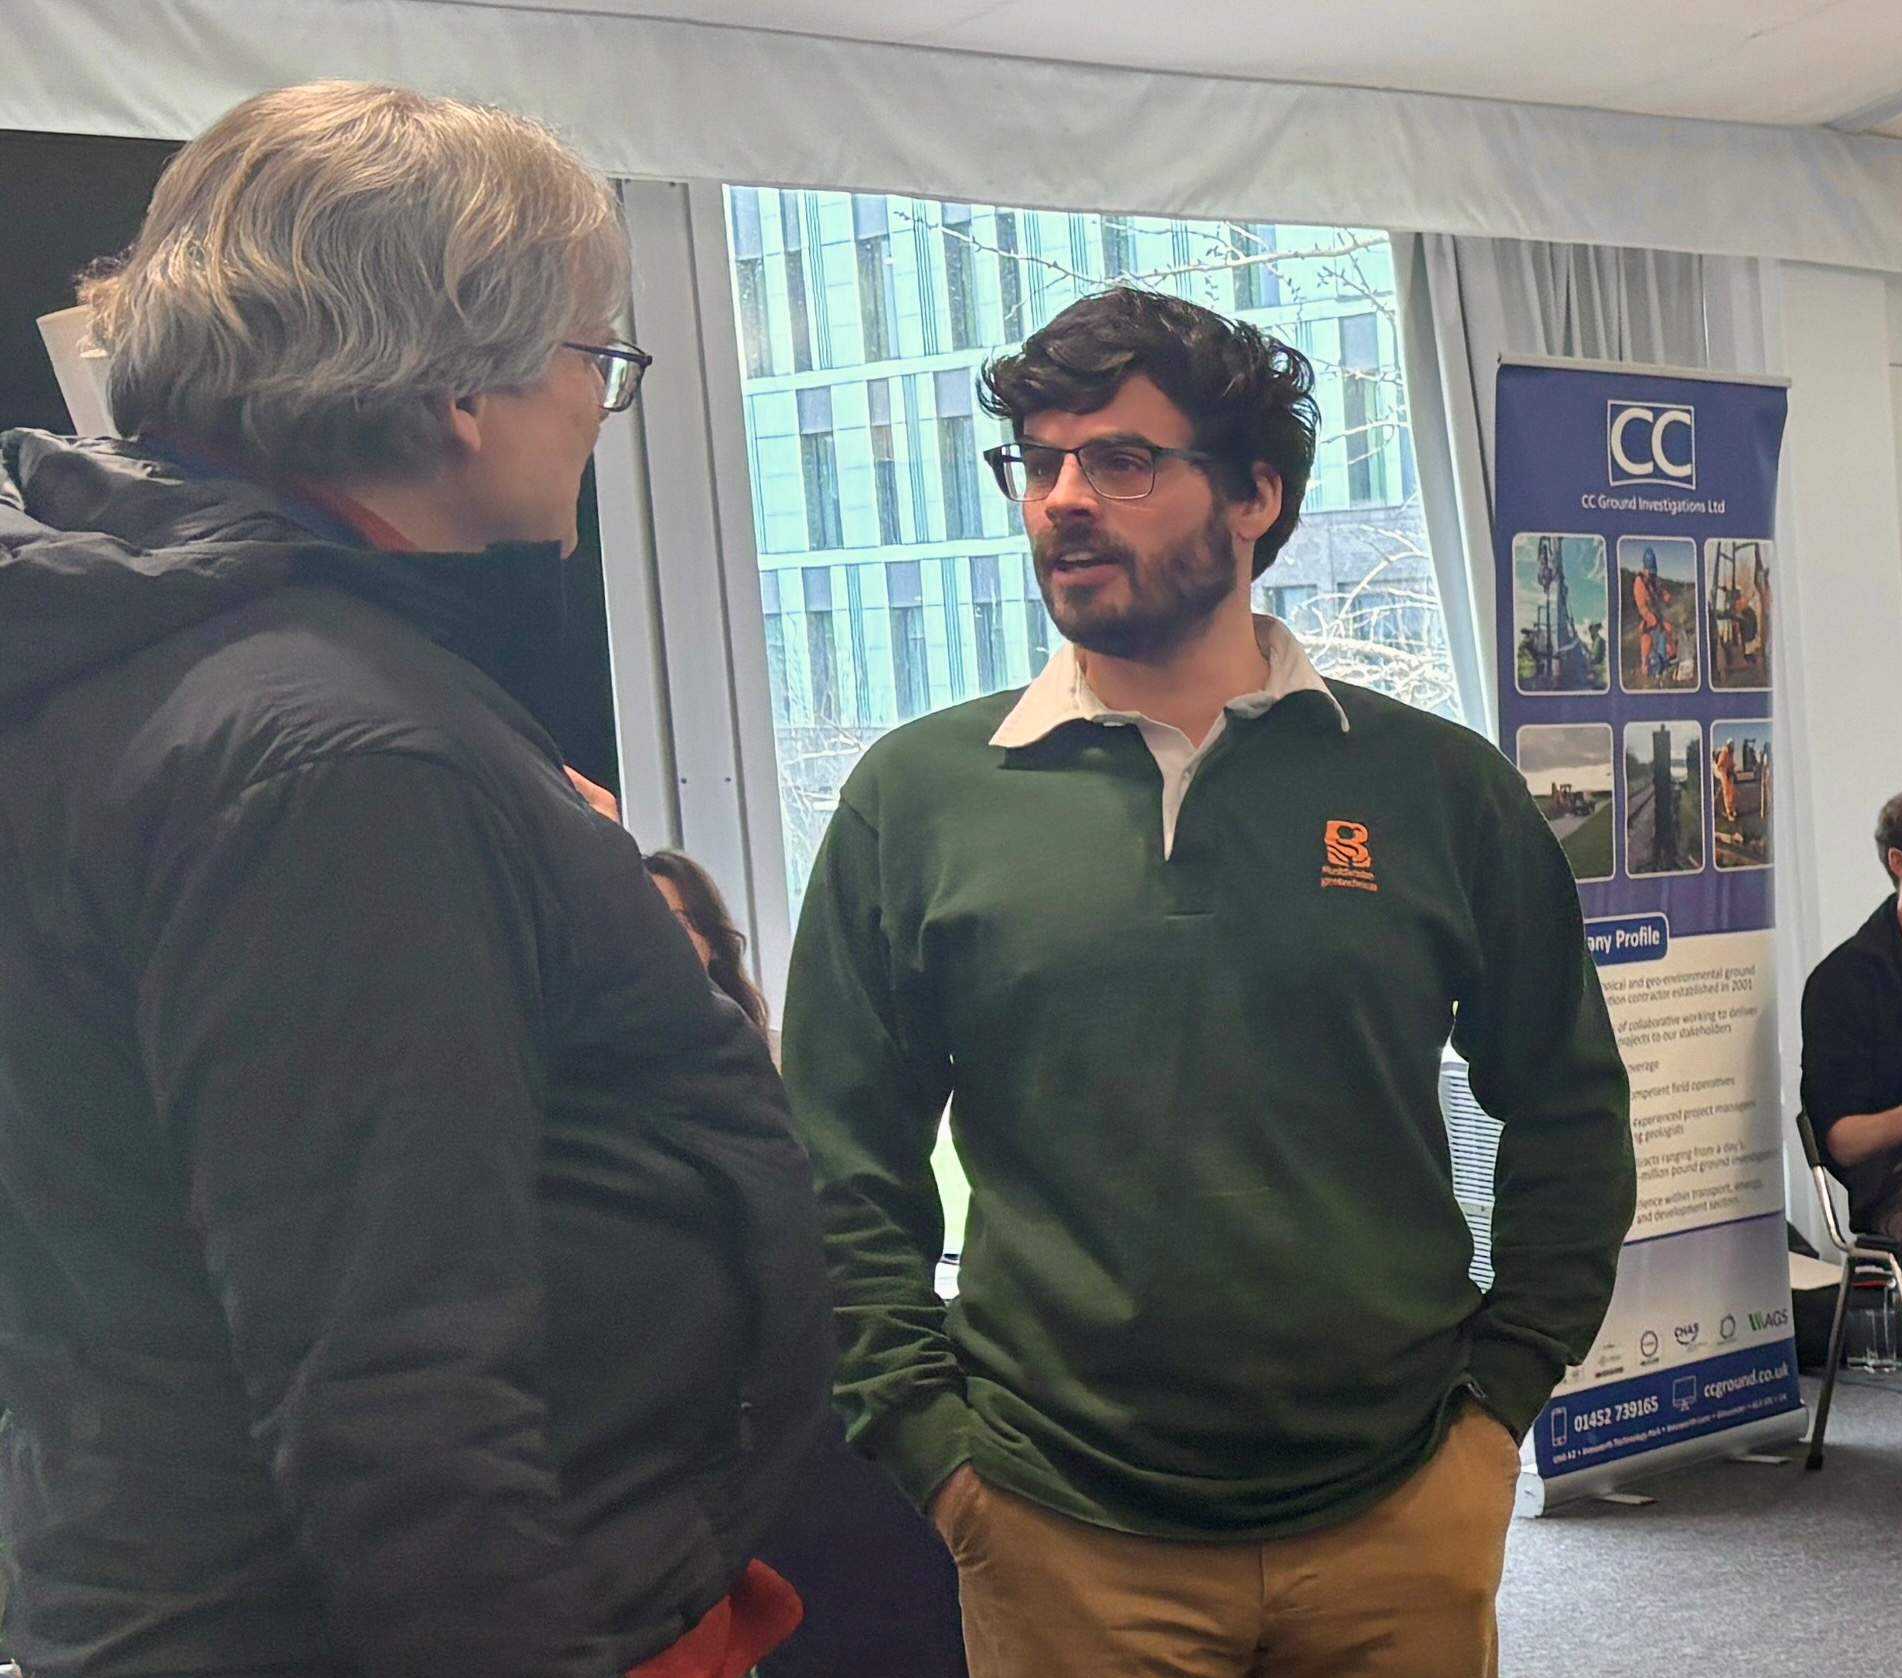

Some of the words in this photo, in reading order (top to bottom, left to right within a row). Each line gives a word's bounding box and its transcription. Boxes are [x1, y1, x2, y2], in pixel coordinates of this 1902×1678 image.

[1611, 407, 1693, 479] CC
[1581, 494, 1597, 510] CC
[1598, 495, 1637, 511] Ground
[1639, 496, 1706, 516] Investigations
[1707, 500, 1727, 514] Ltd
[1616, 925, 1660, 948] Profile
[1762, 1309, 1790, 1331] AGS
[1573, 1409, 1612, 1432] 01452
[1615, 1396, 1660, 1421] 739165
[1703, 1363, 1790, 1399] ccground.co.uk
